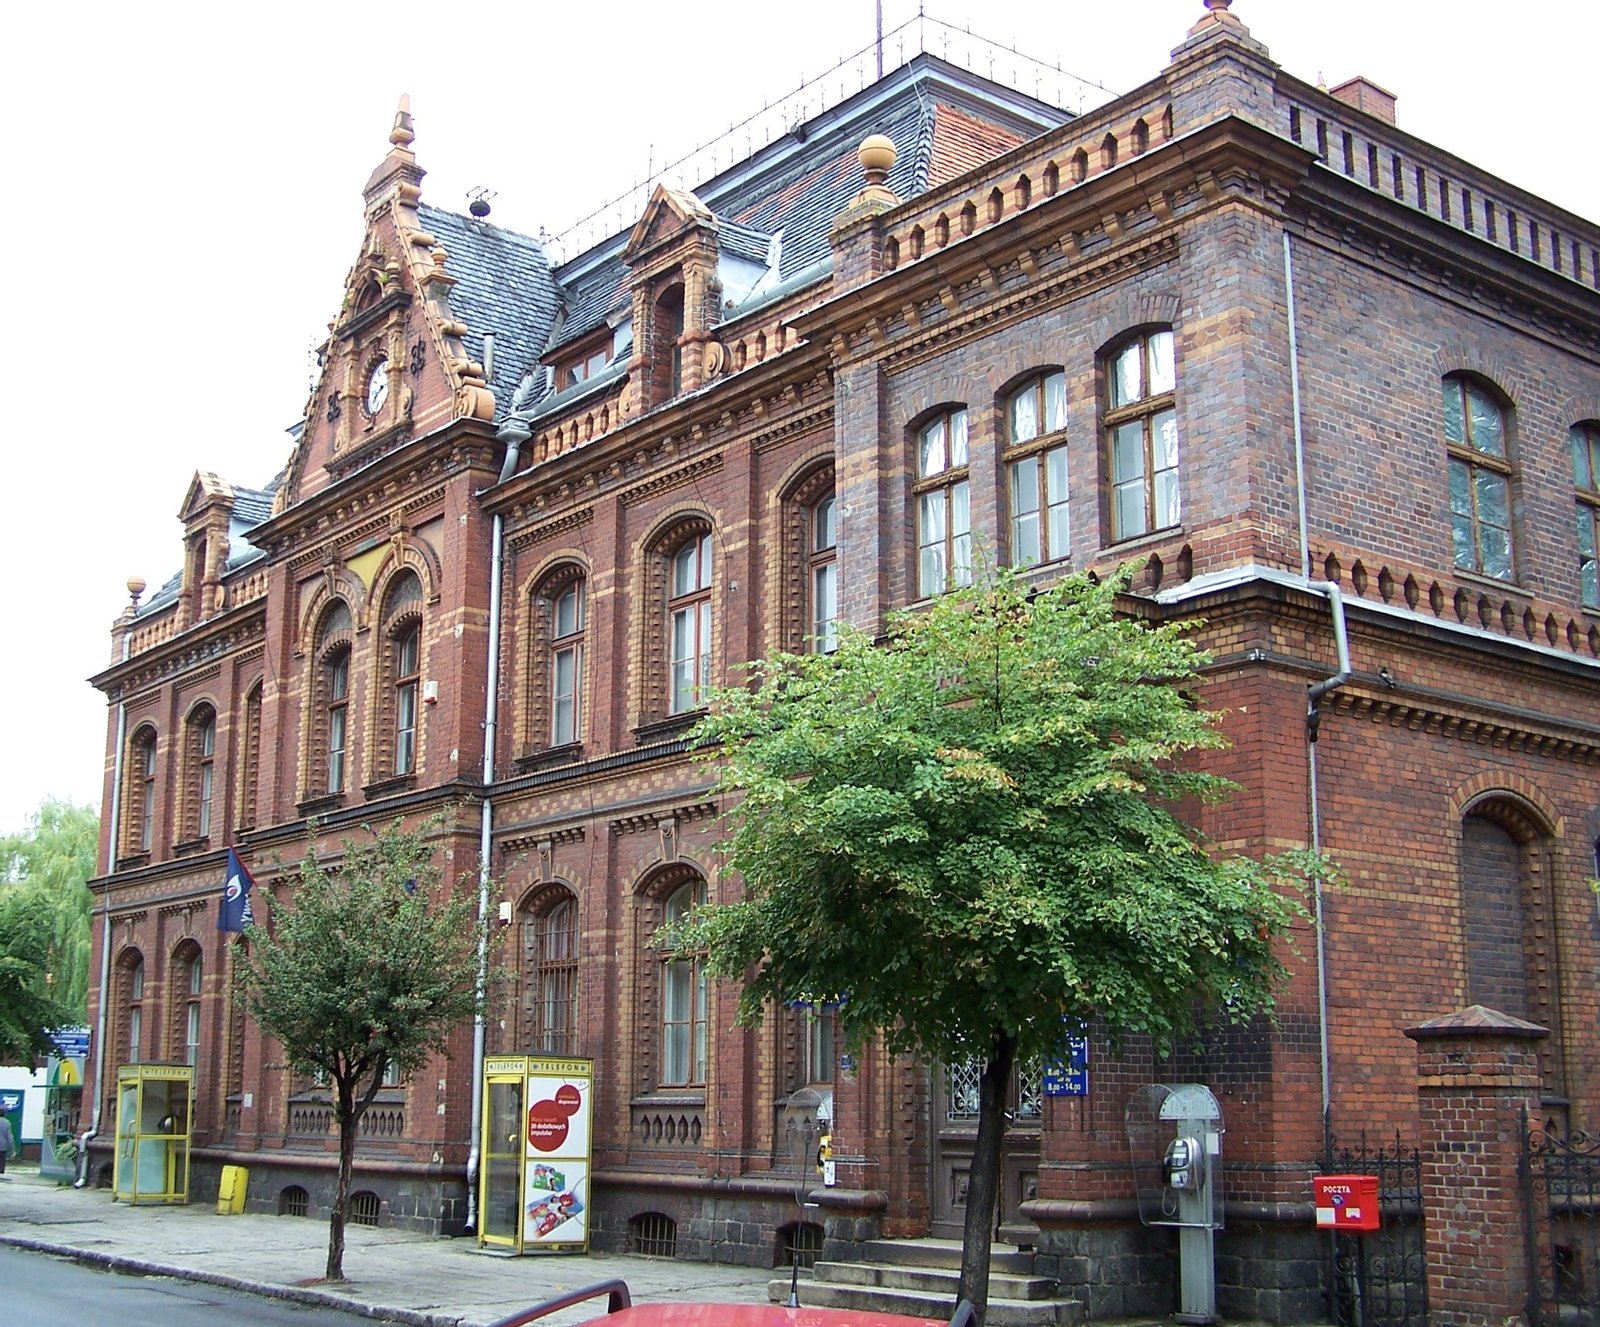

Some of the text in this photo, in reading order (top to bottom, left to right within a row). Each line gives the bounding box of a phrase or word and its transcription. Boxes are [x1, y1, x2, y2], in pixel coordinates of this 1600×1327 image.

[541, 1063, 579, 1071] TELEFON
[1047, 1083, 1060, 1091] 8.00
[1065, 1083, 1081, 1091] 14.00
[1323, 1185, 1351, 1194] POCZTA
